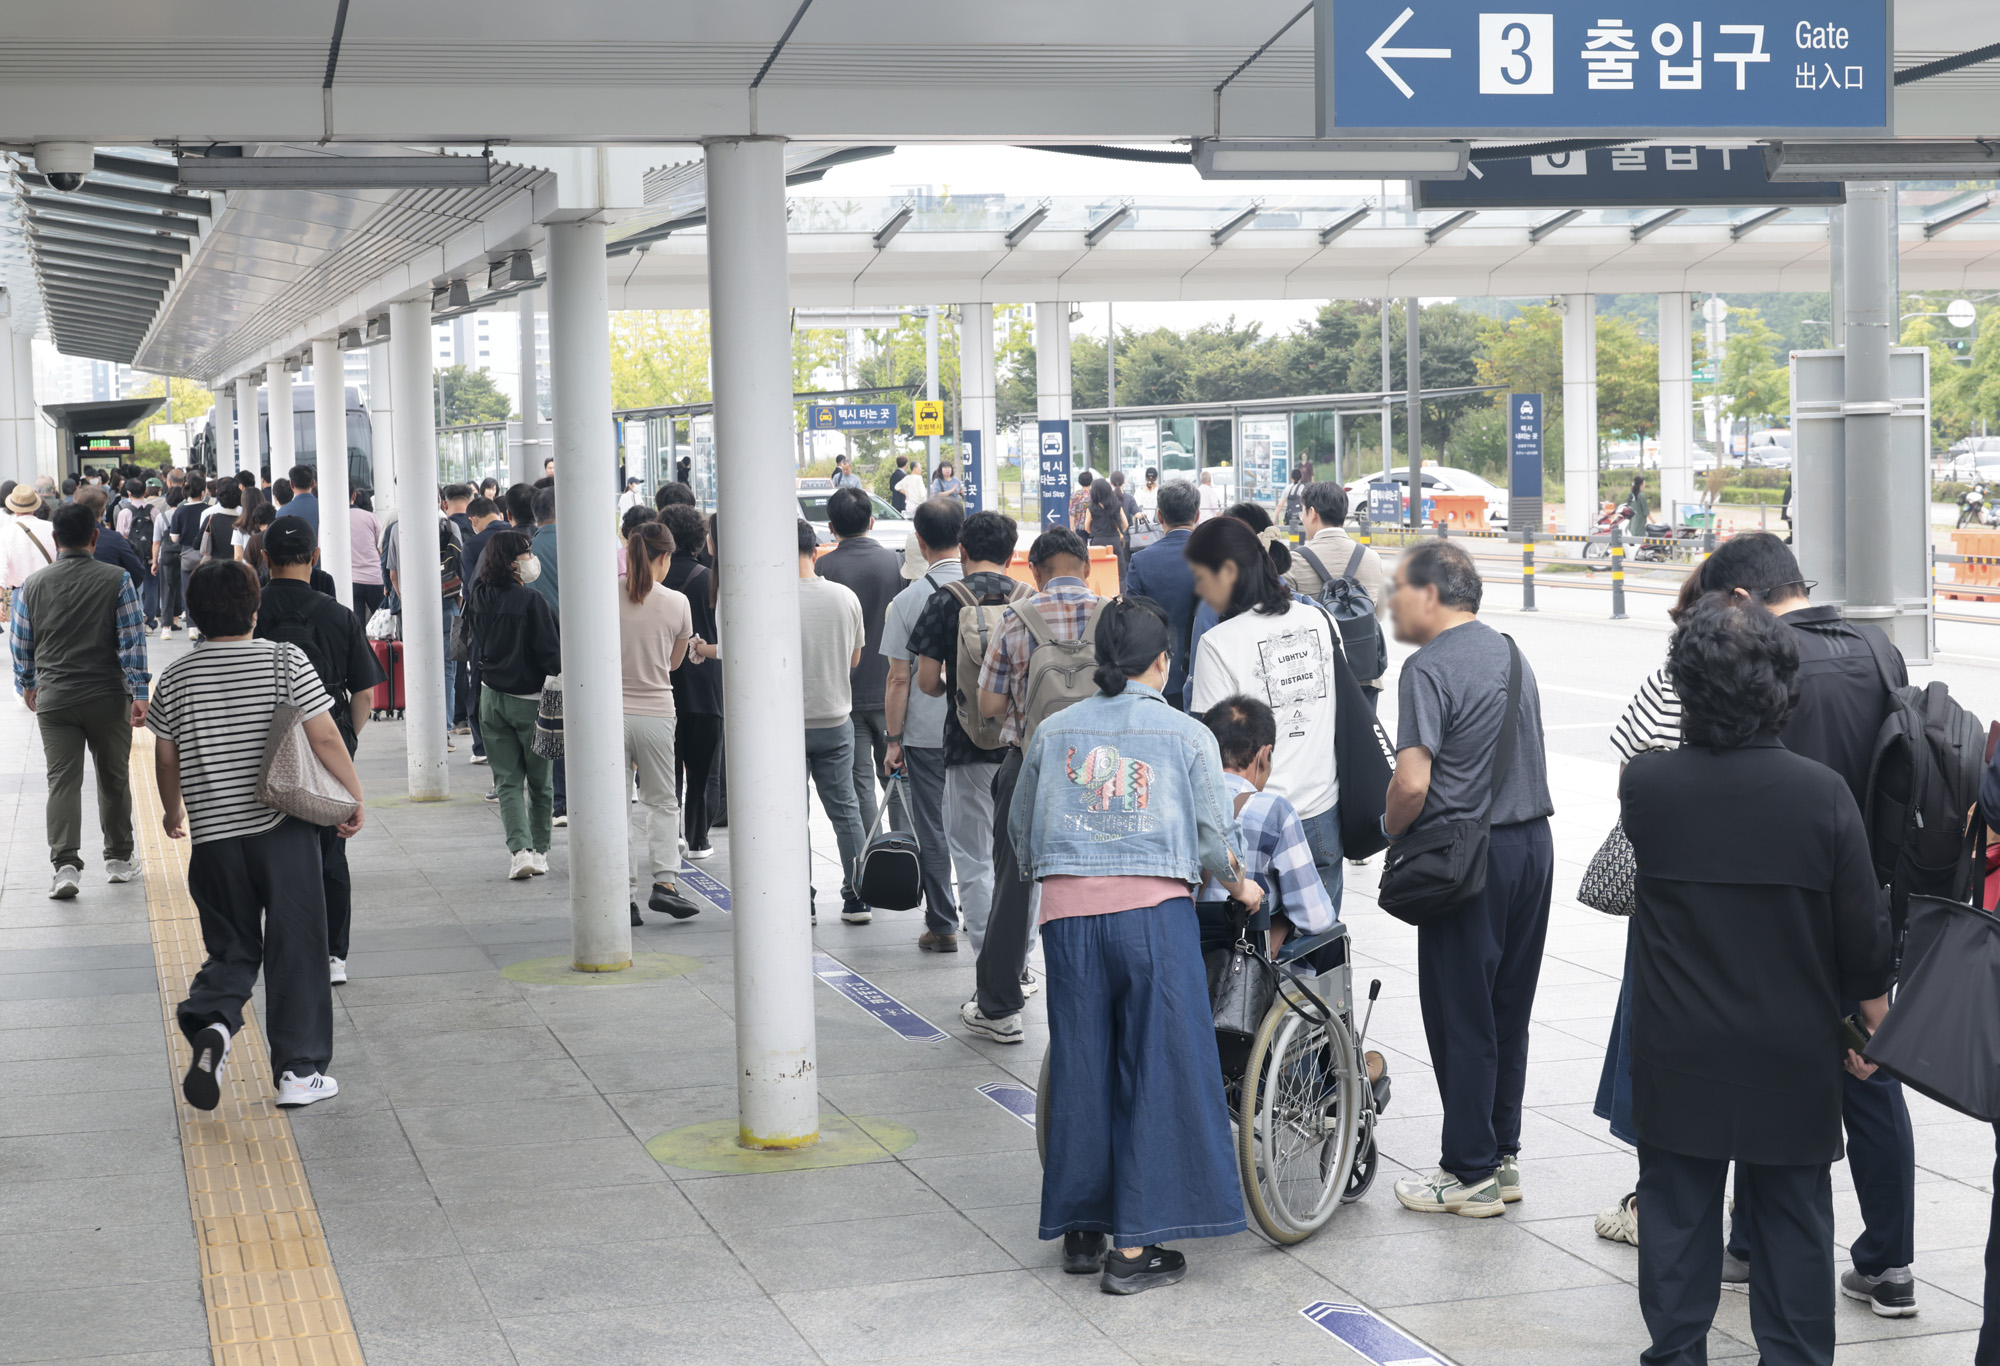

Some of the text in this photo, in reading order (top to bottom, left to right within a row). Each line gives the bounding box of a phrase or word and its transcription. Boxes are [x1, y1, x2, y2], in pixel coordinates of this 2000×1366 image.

[1795, 20, 1850, 50] Gate
[1501, 18, 1771, 91] 3 출입구
[1795, 62, 1864, 91] 出入口
[839, 408, 890, 420] 택시 타는 곳
[917, 423, 942, 431] 모범택시
[1042, 460, 1063, 473] 택시
[962, 471, 973, 483] 시
[1058, 474, 1068, 486] 곳
[968, 484, 978, 496] 곳
[1053, 490, 1066, 498] Stop
[1278, 651, 1308, 664] LIGHTLY
[1280, 672, 1314, 686] DISTANCE
[1373, 724, 1397, 774] UMB
[1089, 833, 1122, 841] LONDON
